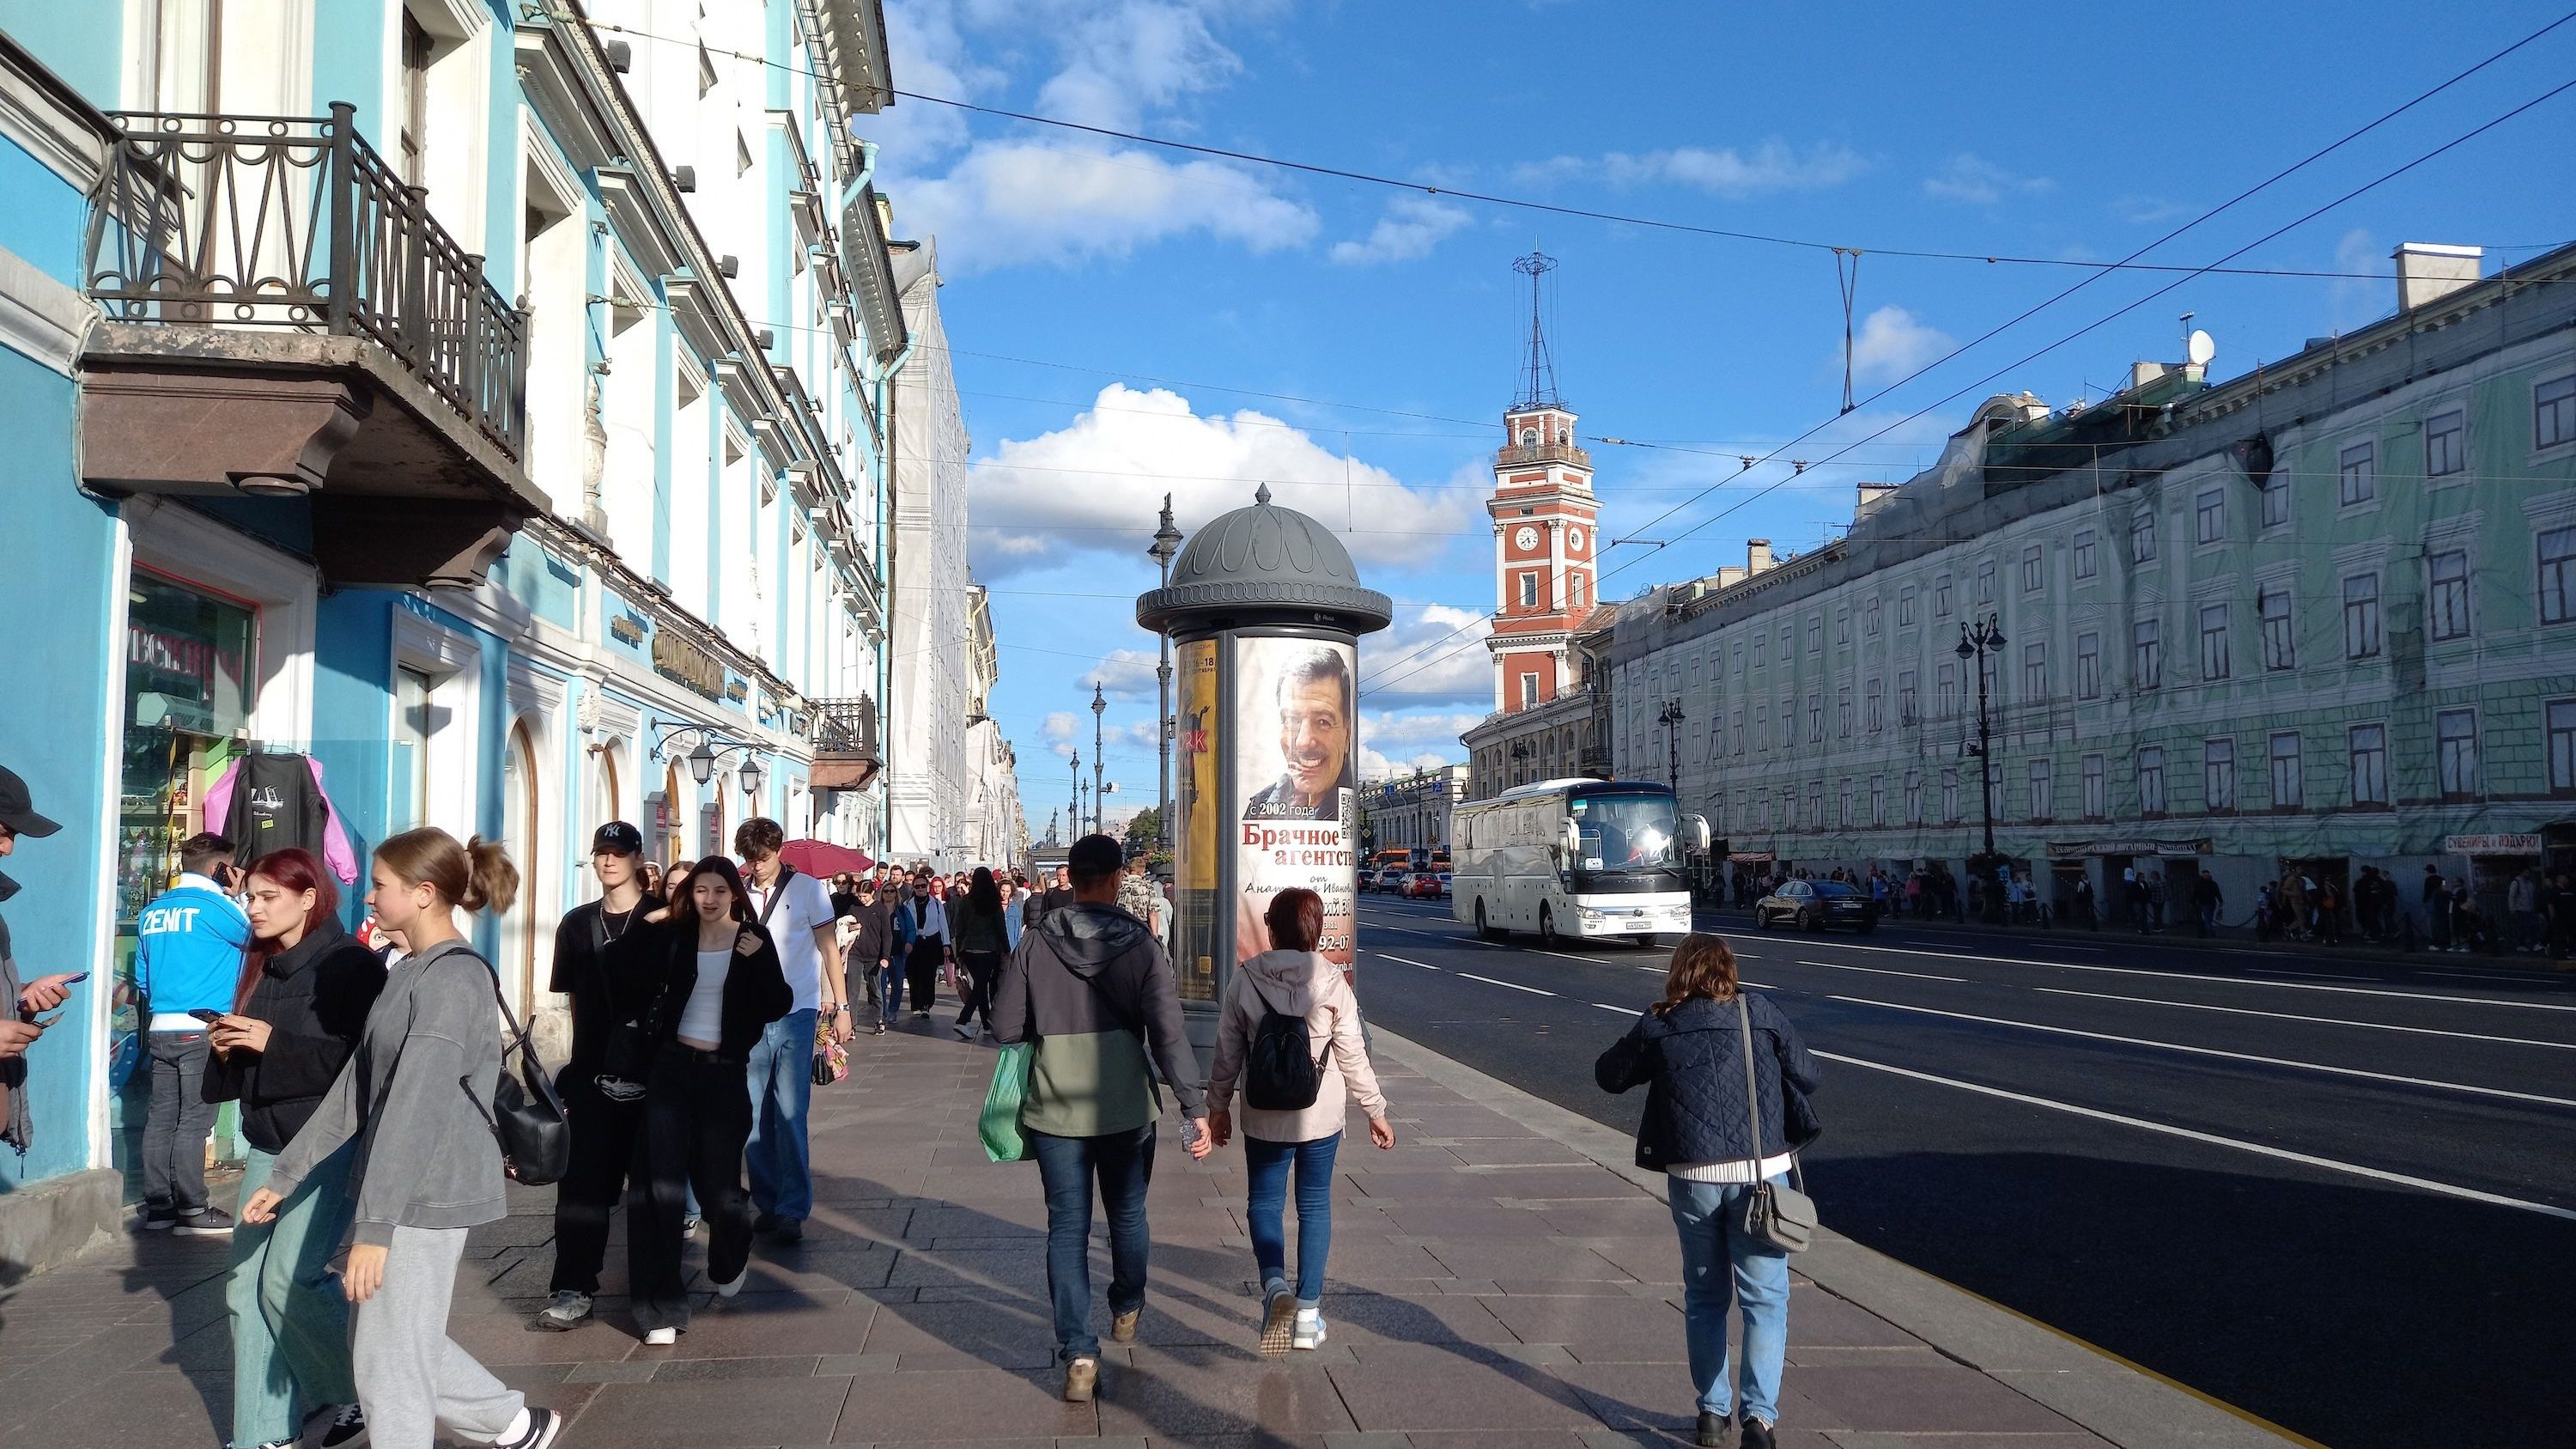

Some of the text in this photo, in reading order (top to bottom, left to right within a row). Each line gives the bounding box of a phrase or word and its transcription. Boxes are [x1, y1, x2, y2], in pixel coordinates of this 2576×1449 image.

[1249, 803, 1315, 817] с 2002 года
[604, 825, 620, 837] NY
[1242, 823, 1340, 851] Брачное
[2447, 836, 2489, 849] СУВЕНИРЫ
[2499, 835, 2539, 849] ПОДАРКИ
[1244, 882, 1320, 893] Анатя
[143, 907, 201, 935] ZENIT
